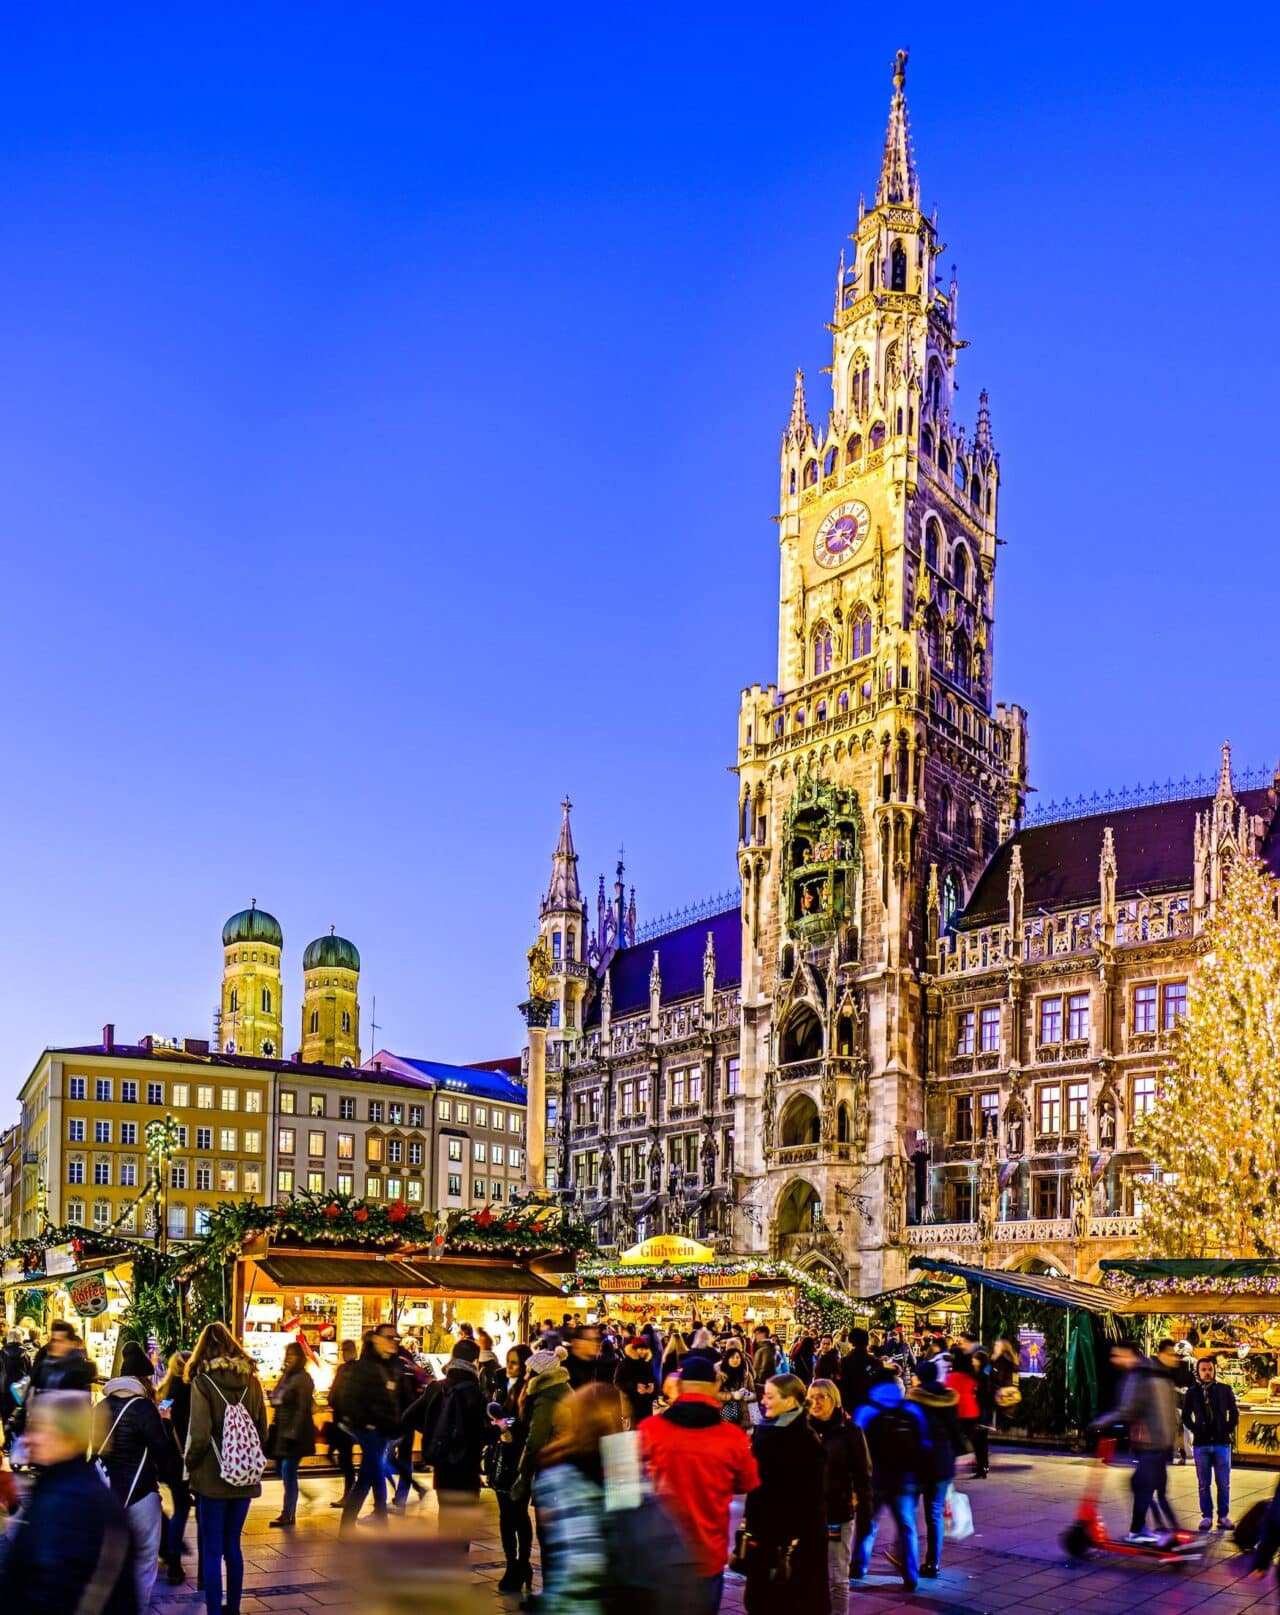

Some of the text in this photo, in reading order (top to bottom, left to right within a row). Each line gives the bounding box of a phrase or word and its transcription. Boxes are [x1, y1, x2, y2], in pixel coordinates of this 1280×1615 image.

[640, 1243, 695, 1258] Glühwein
[600, 1277, 641, 1289] Glühwein
[700, 1275, 746, 1287] Glühwein
